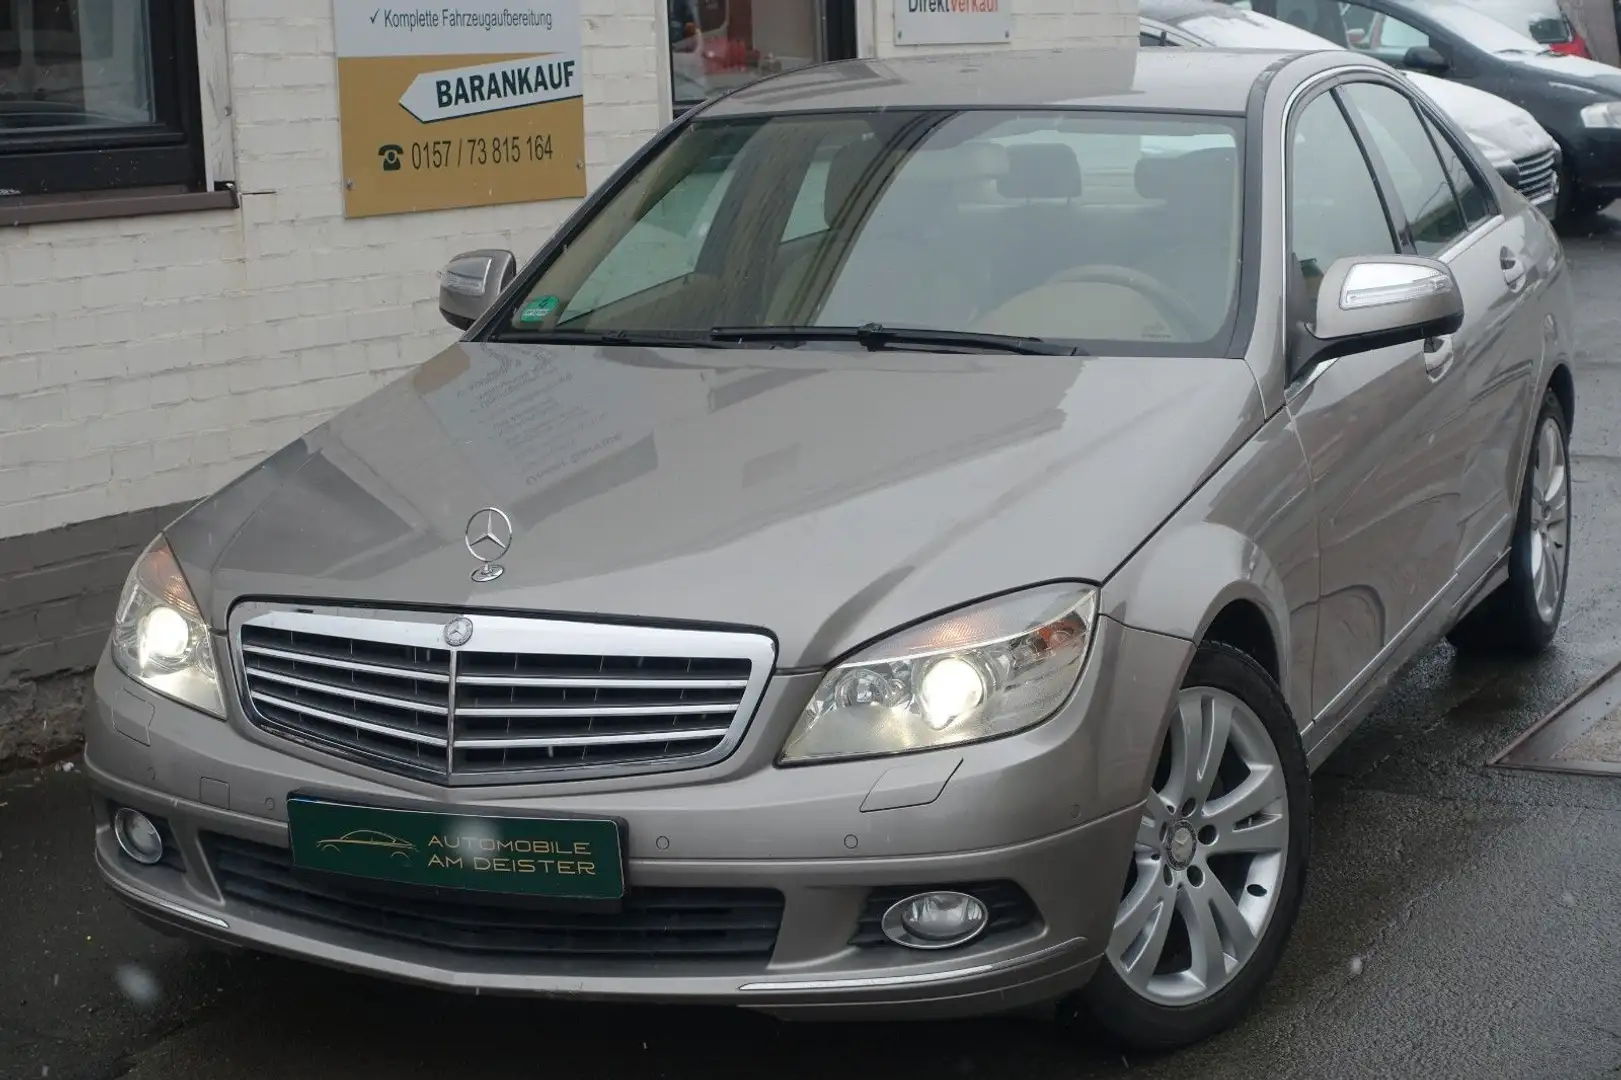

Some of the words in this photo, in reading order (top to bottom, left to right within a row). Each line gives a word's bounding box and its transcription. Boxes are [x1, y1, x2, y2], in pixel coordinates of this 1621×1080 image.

[384, 9, 439, 31] Komplette
[443, 9, 552, 30] Fahrzeugaufbereitung
[436, 60, 575, 108] BARANKAUF
[411, 140, 452, 169] 0157
[468, 137, 487, 165] 73
[492, 136, 521, 163] 815
[527, 134, 553, 161] 164
[428, 835, 591, 855] AUTOMOBILE
[428, 855, 464, 869] AM
[473, 857, 596, 875] DEISTER
